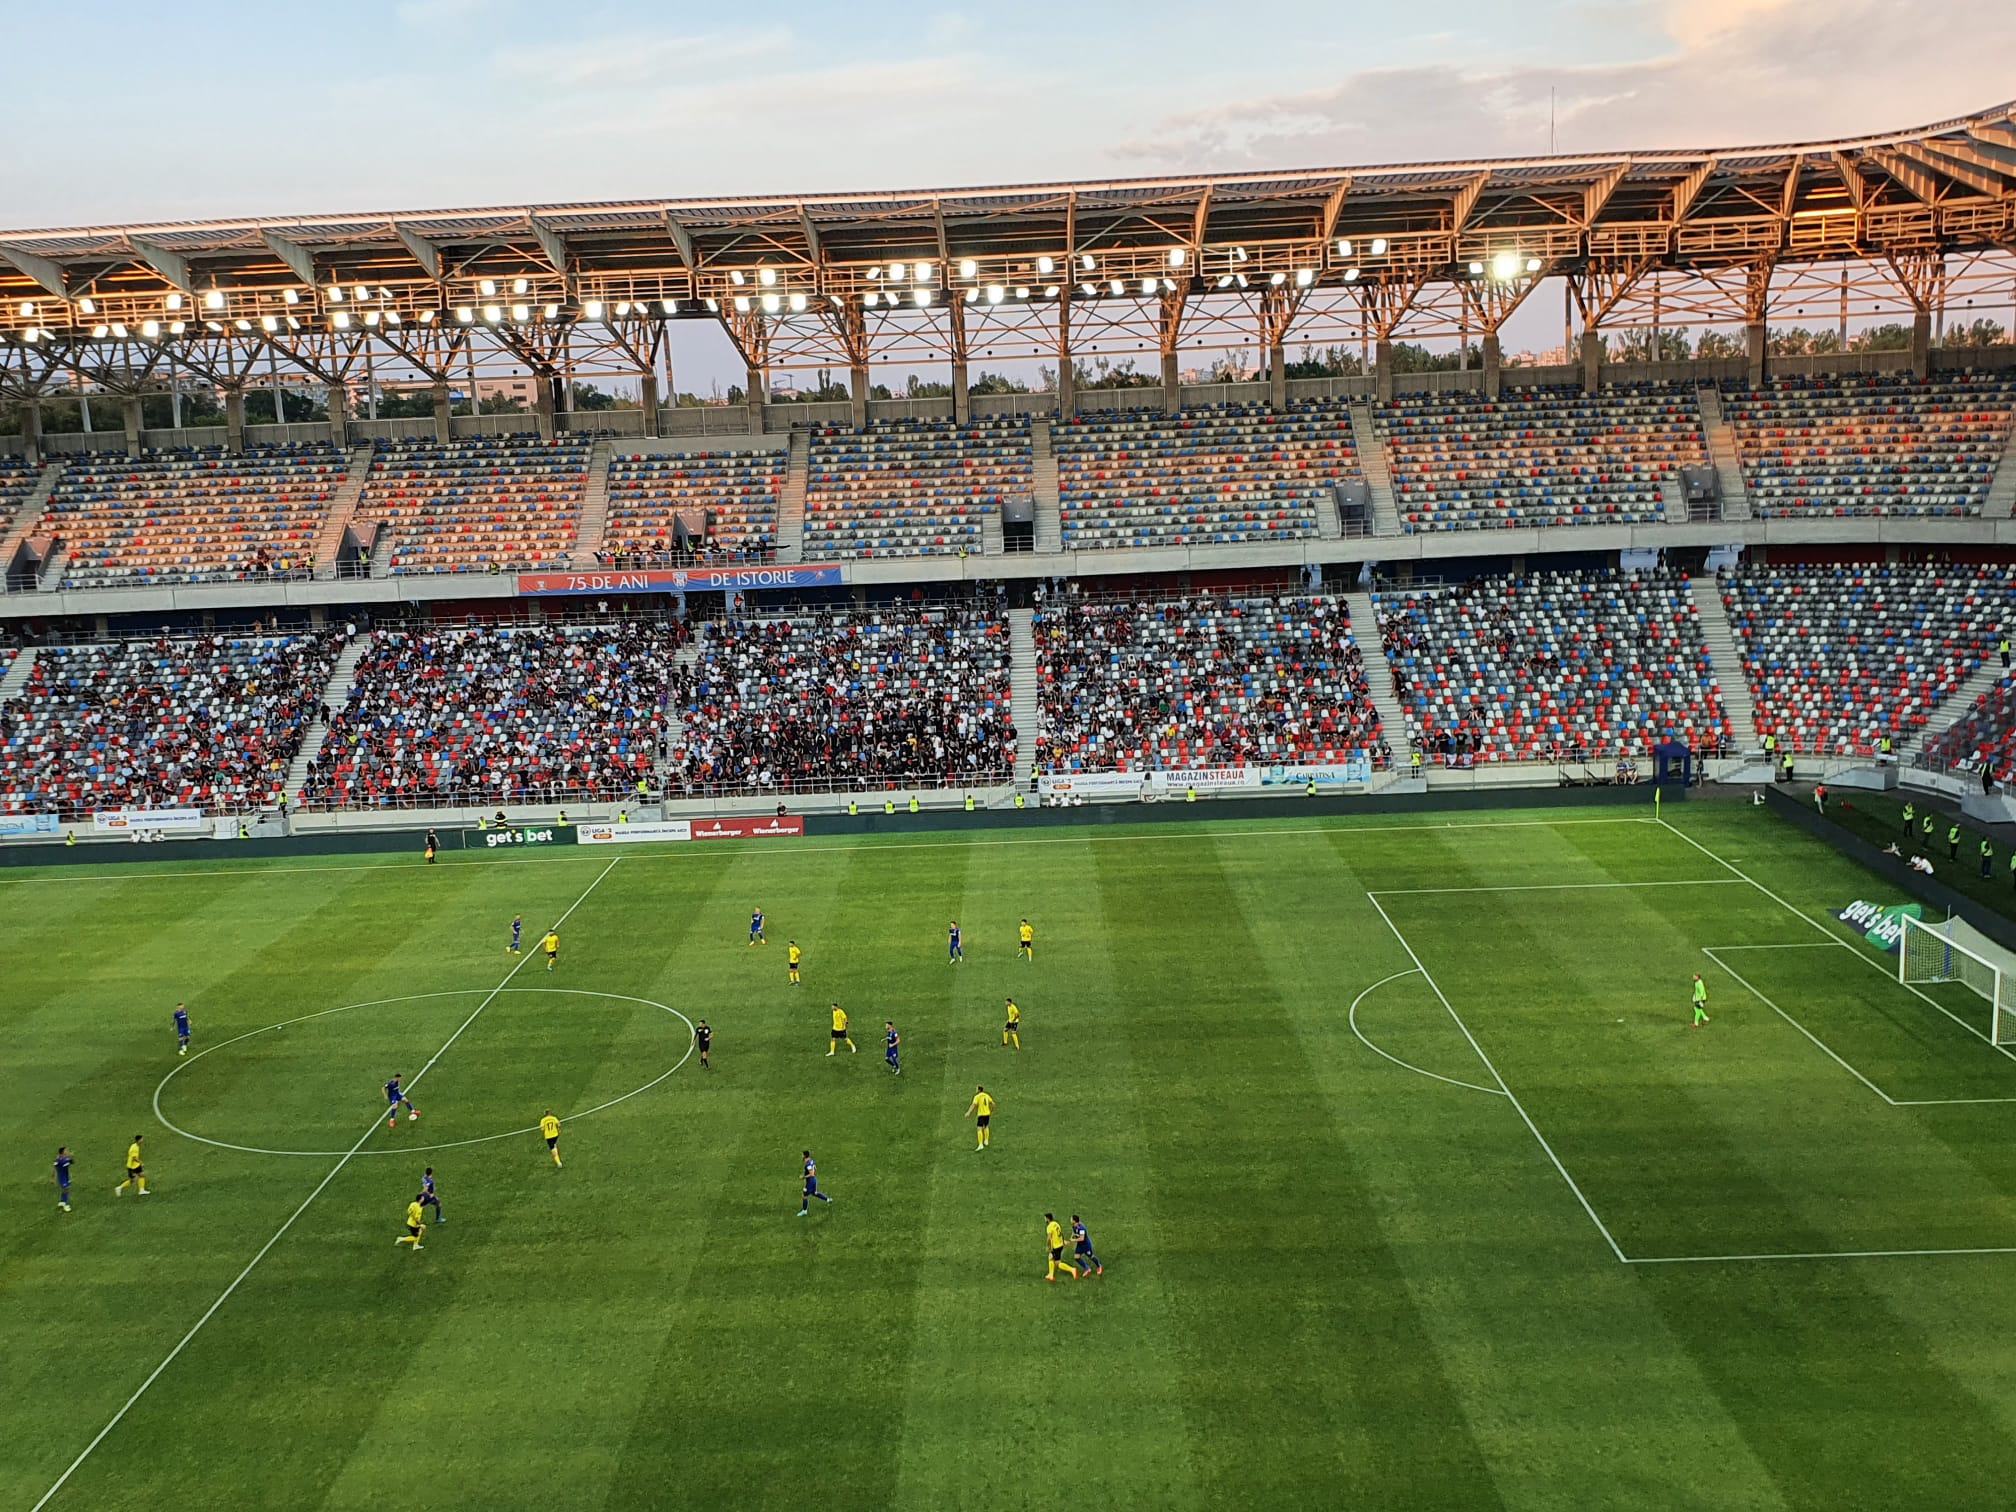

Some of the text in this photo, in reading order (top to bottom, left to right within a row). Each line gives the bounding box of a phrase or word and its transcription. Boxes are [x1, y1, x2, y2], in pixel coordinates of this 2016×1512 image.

[566, 575, 649, 591] 75 DE ANI
[710, 569, 796, 587] DE ISTORIE
[527, 829, 553, 842] bet
[1871, 913, 1902, 945] bet
